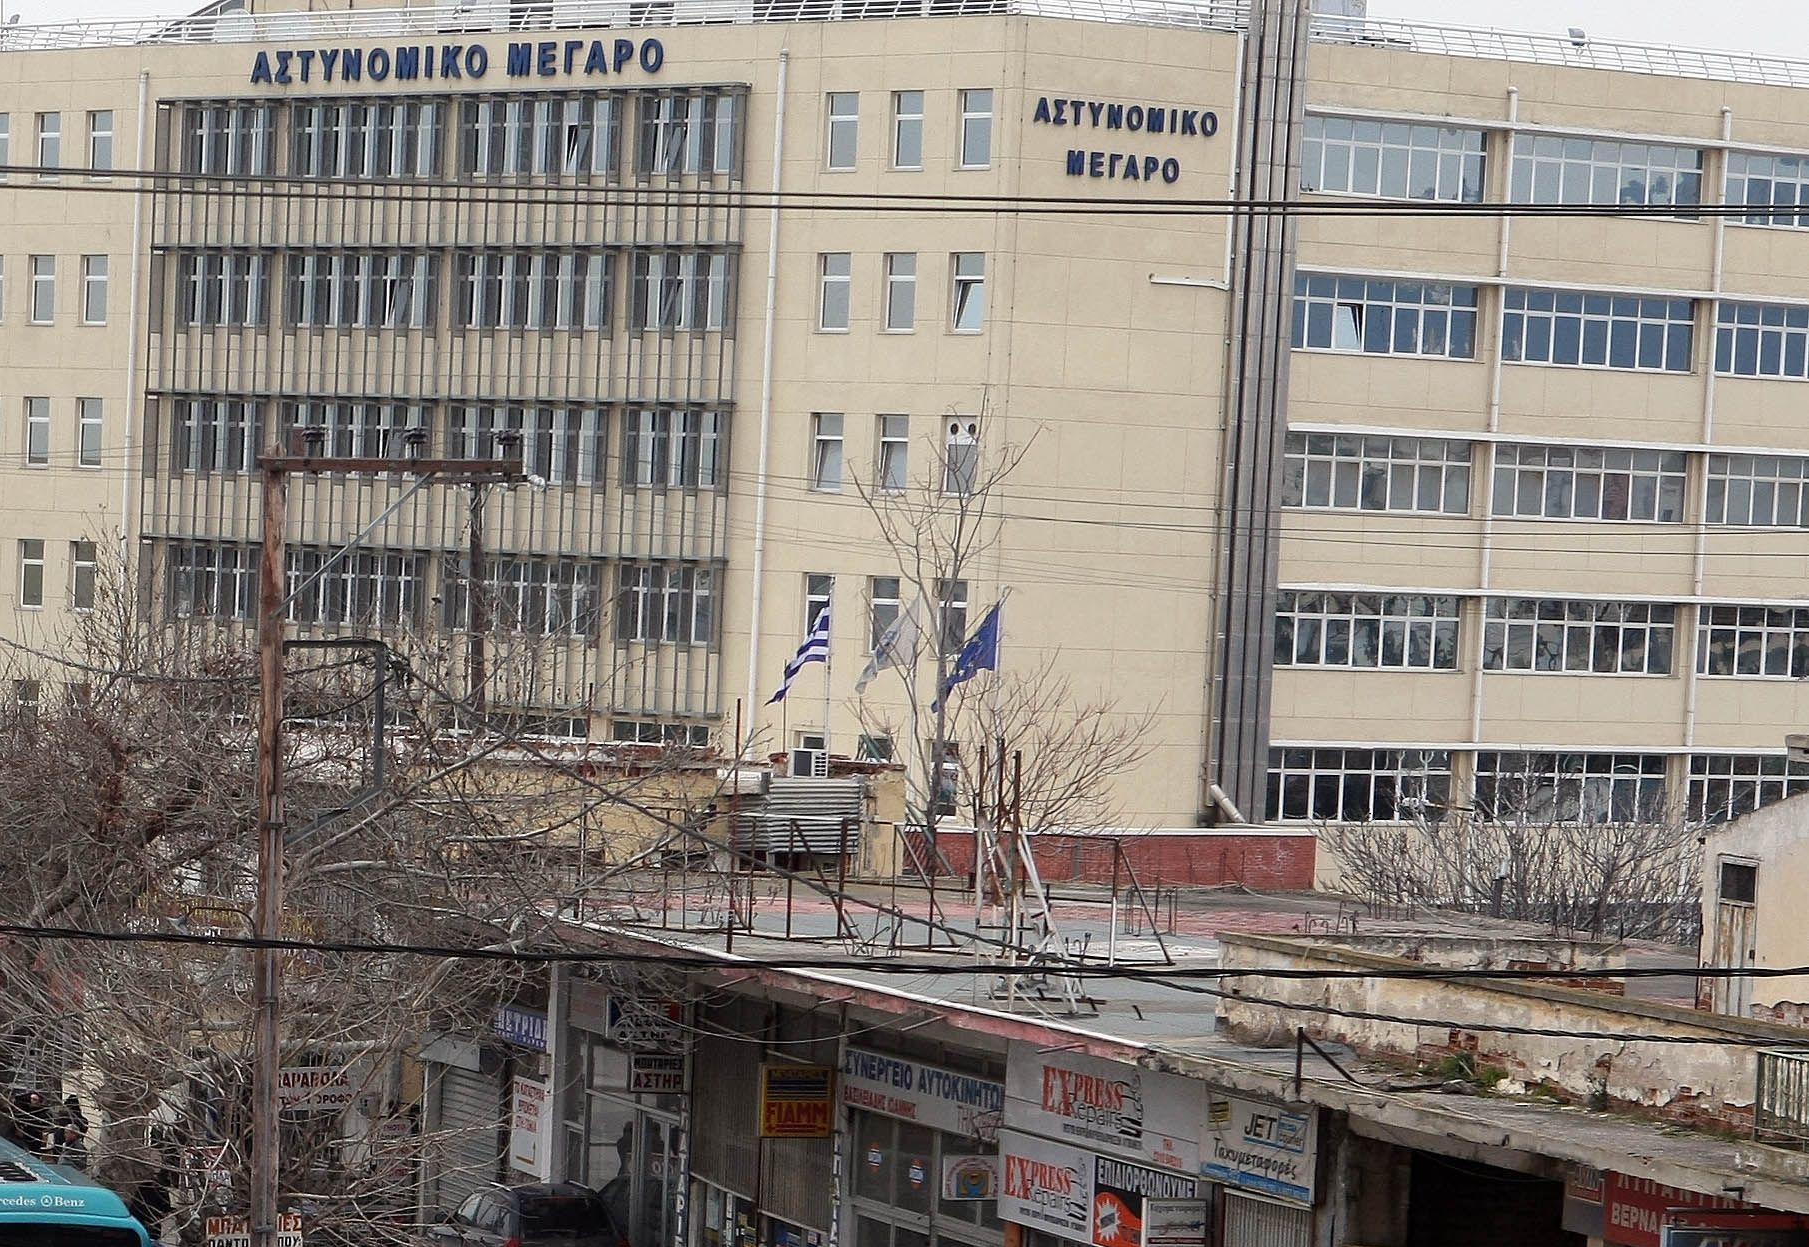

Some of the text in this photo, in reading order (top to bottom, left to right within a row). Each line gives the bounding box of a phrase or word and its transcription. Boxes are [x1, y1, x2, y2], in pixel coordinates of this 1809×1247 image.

[249, 38, 665, 84] ΑΣΤΥΝΟΜΙΚΟ ΜΕΓΑΡΟ
[1033, 96, 1219, 137] ΑΣΤΥΝΟΜΙΚΟ
[1066, 149, 1180, 184] ΜΕΓΑΡΟ
[279, 1070, 349, 1089] ΑΡΑΒΟΛΑ
[632, 1073, 683, 1089] ΑΣΤΗΡ
[845, 1050, 913, 1091] ΣΥΝΕΡΓΕΙΟ
[1043, 1065, 1124, 1118] EXPRESS
[766, 1102, 828, 1123] FIAMM
[1244, 1113, 1278, 1140] JET
[1004, 1155, 1072, 1200] EXPRESS
[1213, 1136, 1298, 1181] Ταχυμεταφορές
[54, 1195, 85, 1207] Benz
